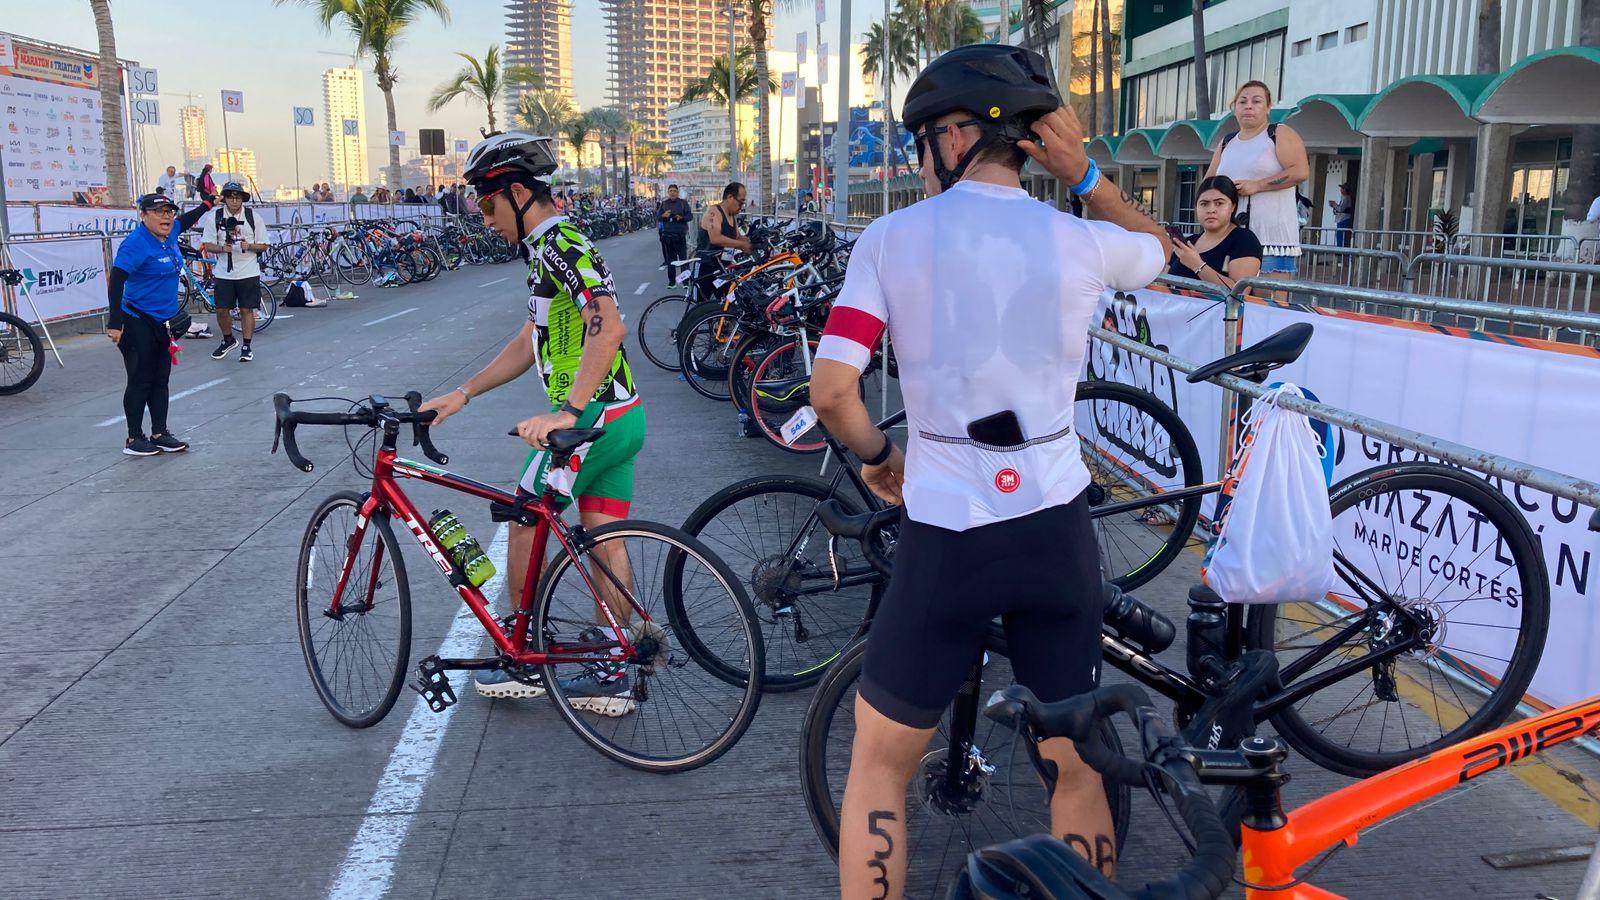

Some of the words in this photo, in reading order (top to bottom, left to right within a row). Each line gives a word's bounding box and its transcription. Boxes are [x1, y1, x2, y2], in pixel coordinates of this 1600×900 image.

[134, 71, 156, 93] SG
[227, 96, 240, 106] SJ
[136, 101, 158, 124] SH
[296, 108, 314, 125] SO
[39, 269, 64, 287] ETN
[790, 419, 807, 435] 544
[1001, 474, 1015, 483] 3M
[406, 512, 454, 580] TRE
[1355, 488, 1591, 596] MAZATLN
[1354, 521, 1391, 555] MAR
[1397, 540, 1421, 568] DE
[1428, 554, 1519, 609] CORTÉS
